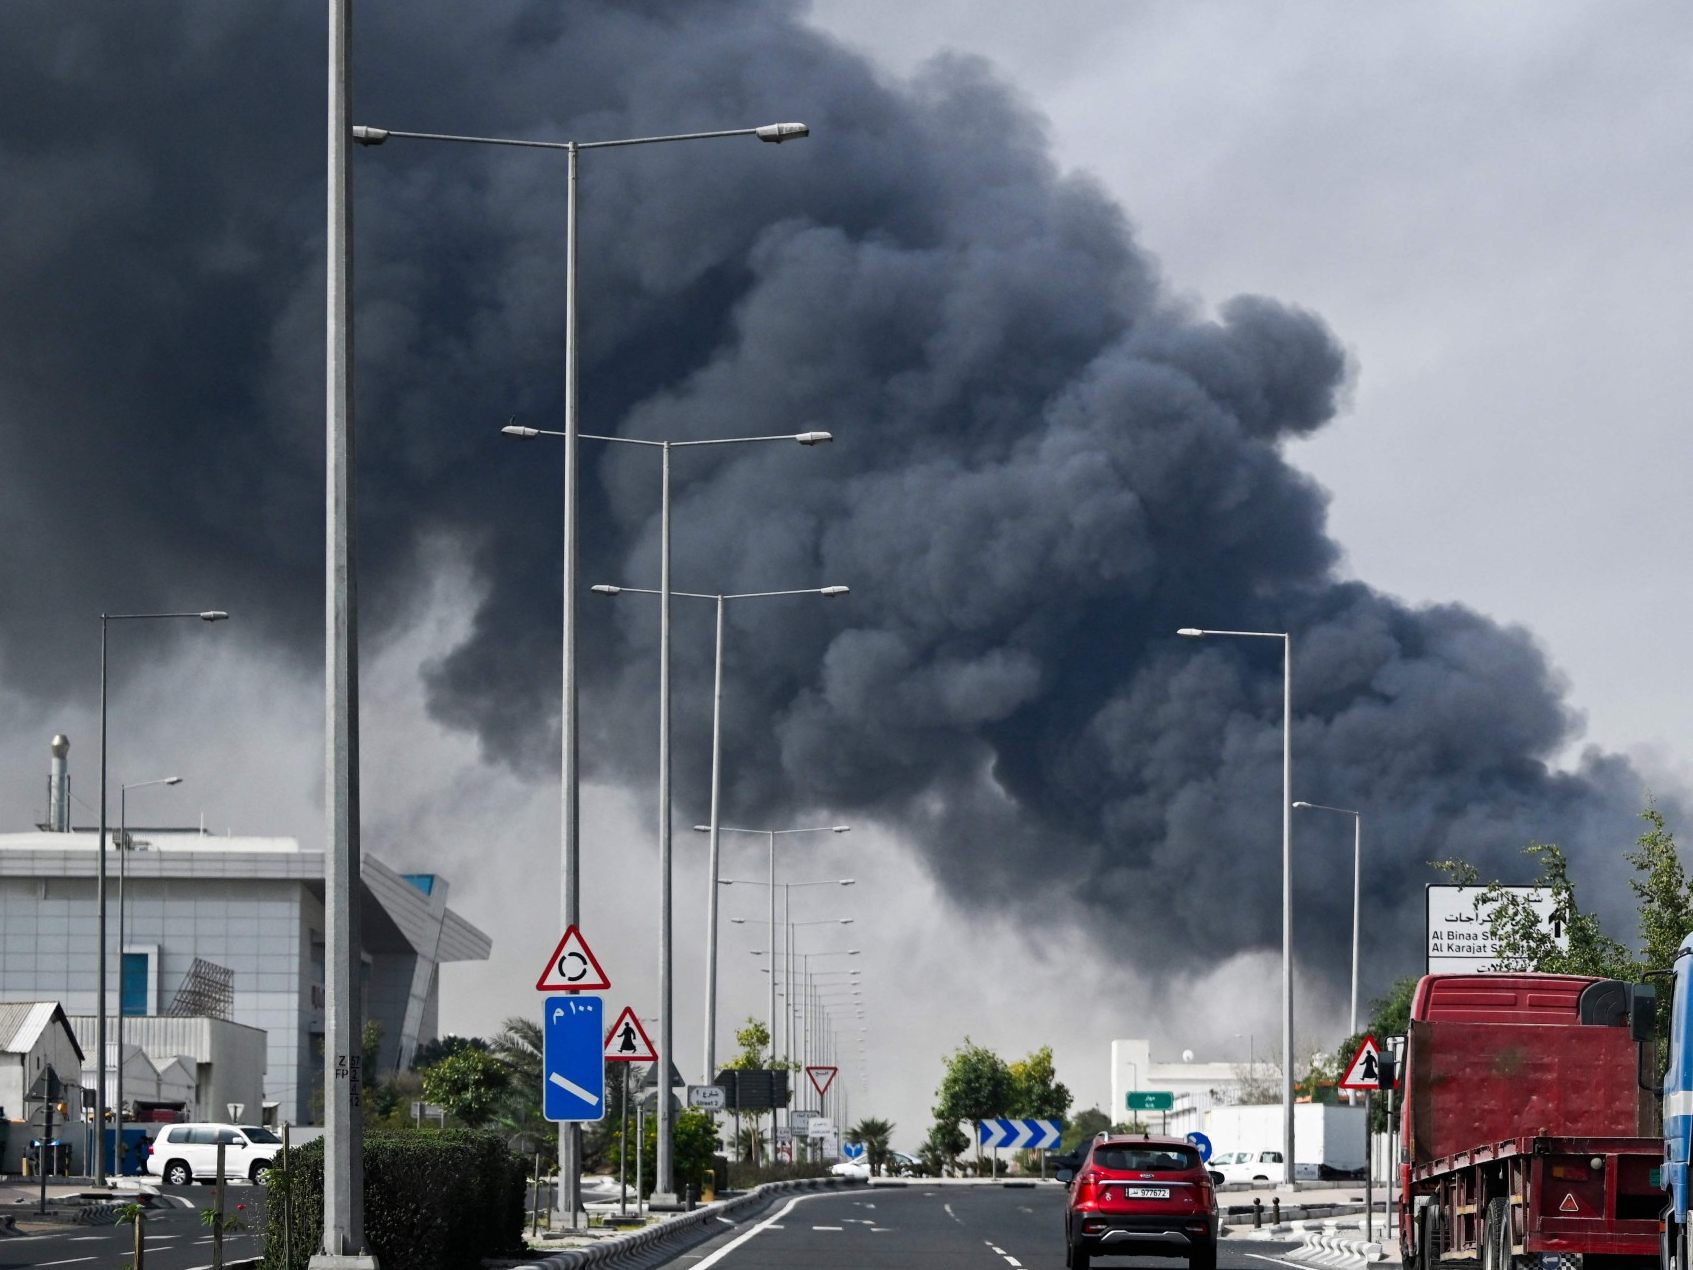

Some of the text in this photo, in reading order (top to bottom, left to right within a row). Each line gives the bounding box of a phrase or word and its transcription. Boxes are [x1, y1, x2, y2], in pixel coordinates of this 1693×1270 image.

[1432, 931, 1443, 941] Al
[1447, 931, 1478, 941] Binaa
[1432, 943, 1443, 953] Al
[1447, 943, 1487, 955] Karajat
[552, 1007, 565, 1026] م
[338, 1055, 346, 1067] Z
[335, 1068, 348, 1079] FP
[1140, 1189, 1166, 1197] 977672
